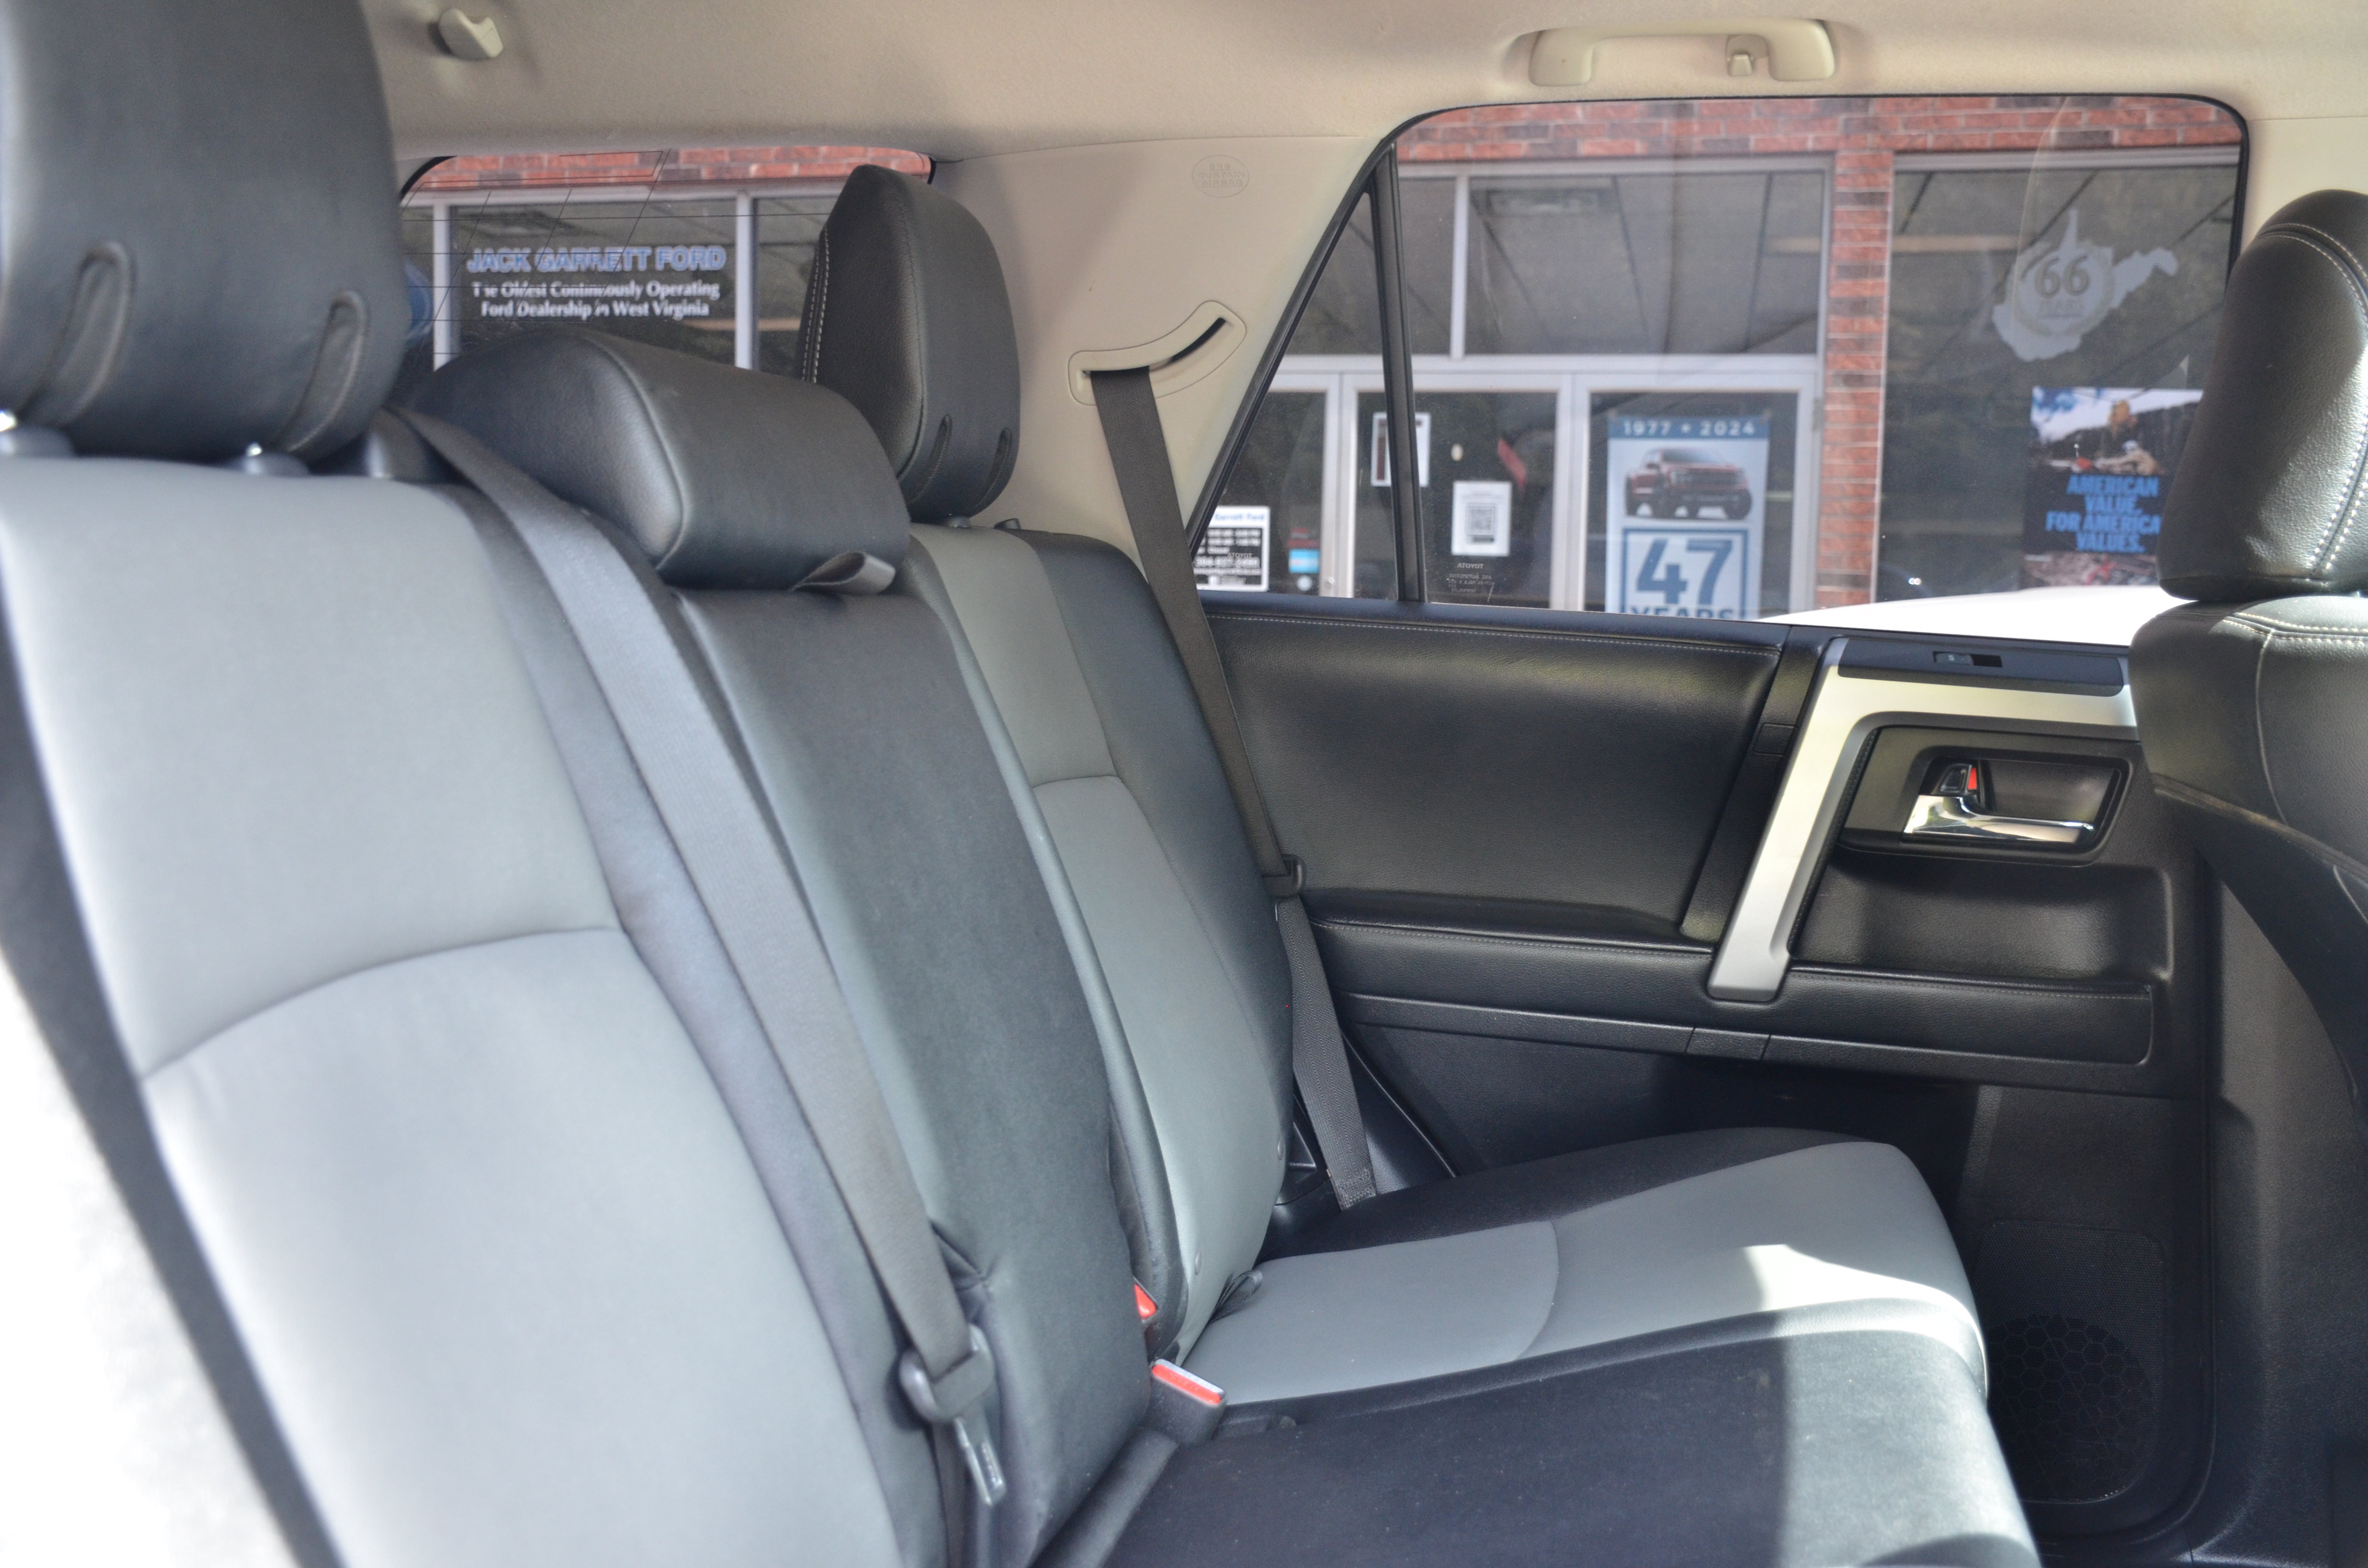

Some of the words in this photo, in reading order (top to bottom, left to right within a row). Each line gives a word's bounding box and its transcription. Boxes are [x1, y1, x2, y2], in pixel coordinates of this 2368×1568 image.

[466, 247, 532, 272] JACK
[535, 246, 653, 272] GARRETT
[654, 245, 727, 271] FORD
[2034, 254, 2090, 299] 66
[501, 280, 547, 298] Oldest
[550, 279, 644, 301] Continuously
[646, 280, 720, 301] Operating
[481, 299, 513, 317] Ford
[517, 299, 592, 321] Dealership
[593, 299, 609, 317] in
[612, 300, 650, 317] West
[652, 299, 710, 321] Virginia
[1623, 420, 1672, 437] 1977
[1700, 419, 1755, 437] 2024
[2066, 474, 2160, 498] AMERICAN
[2045, 510, 2081, 532] FOR
[2082, 514, 2161, 535] AMERICA
[1636, 539, 1733, 605] 47
